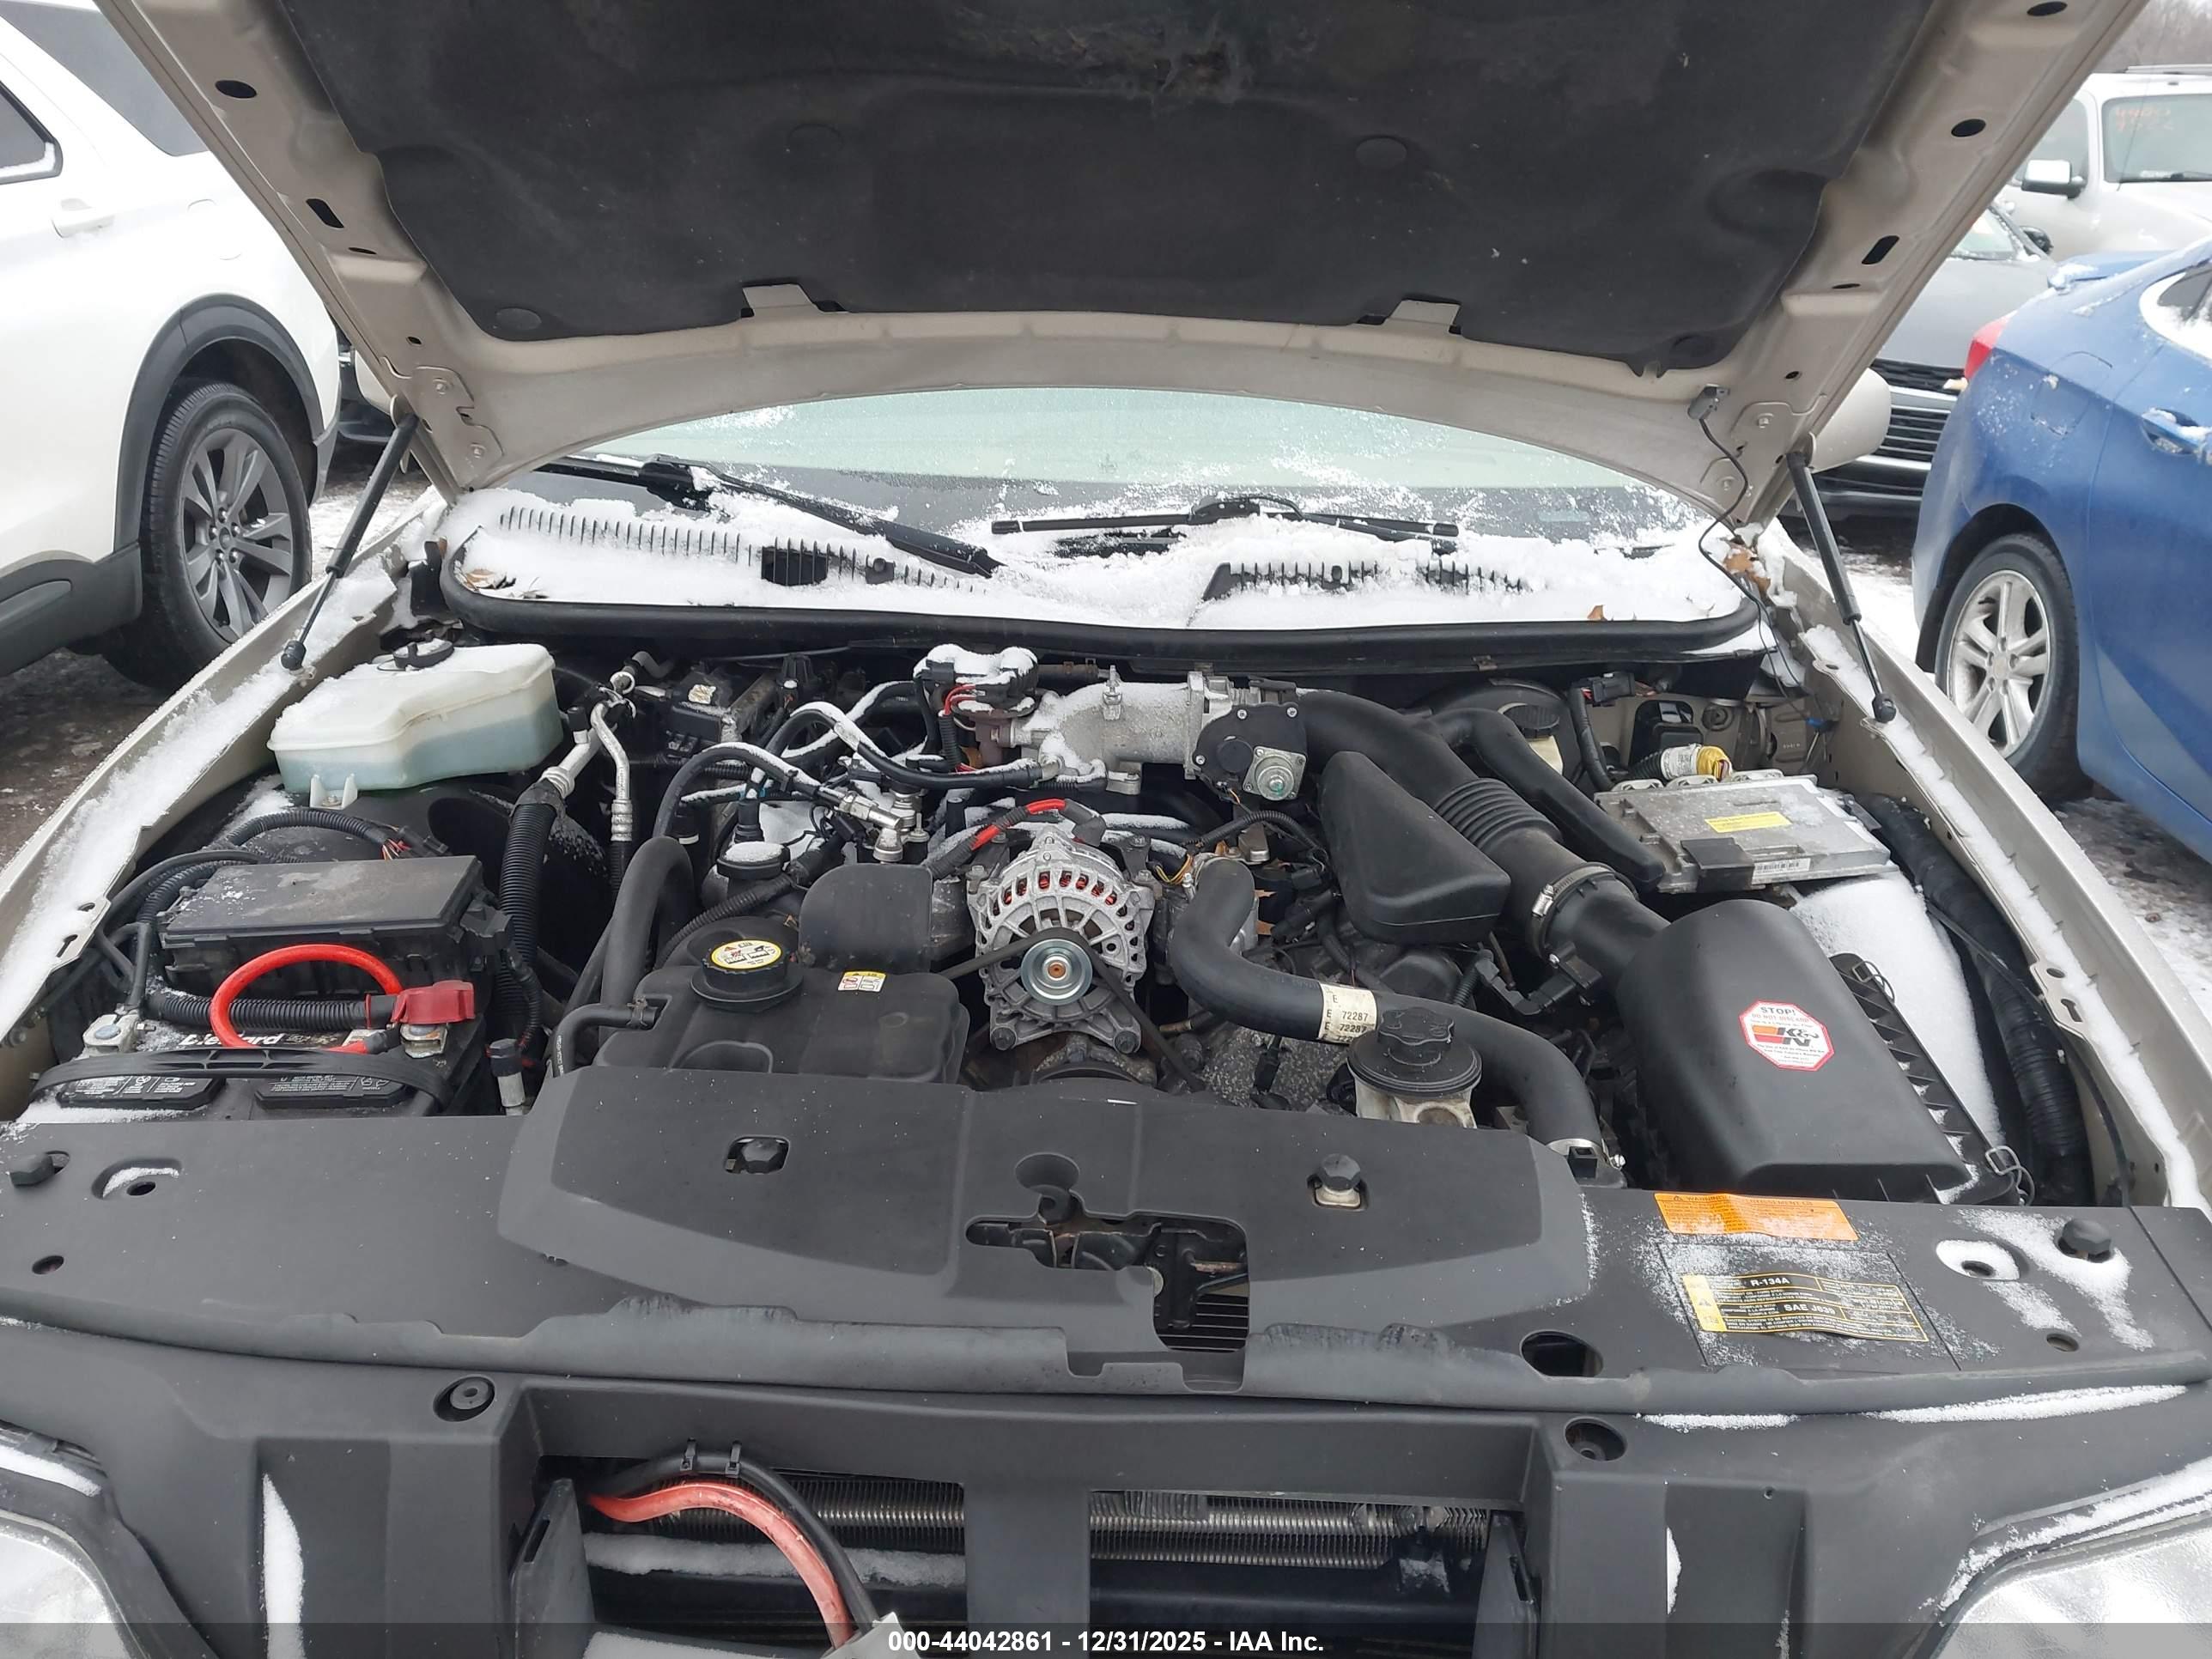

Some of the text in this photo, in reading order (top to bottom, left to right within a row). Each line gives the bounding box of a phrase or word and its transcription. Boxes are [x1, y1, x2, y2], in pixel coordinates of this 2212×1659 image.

[1327, 1009, 1369, 1022] E 72287
[1760, 1006, 1796, 1016] STOP!
[1324, 1022, 1367, 1034] E 72287
[178, 1032, 286, 1046] Dieard
[1750, 1277, 1791, 1287] R-134A
[1784, 1304, 1836, 1315] SAE J639
